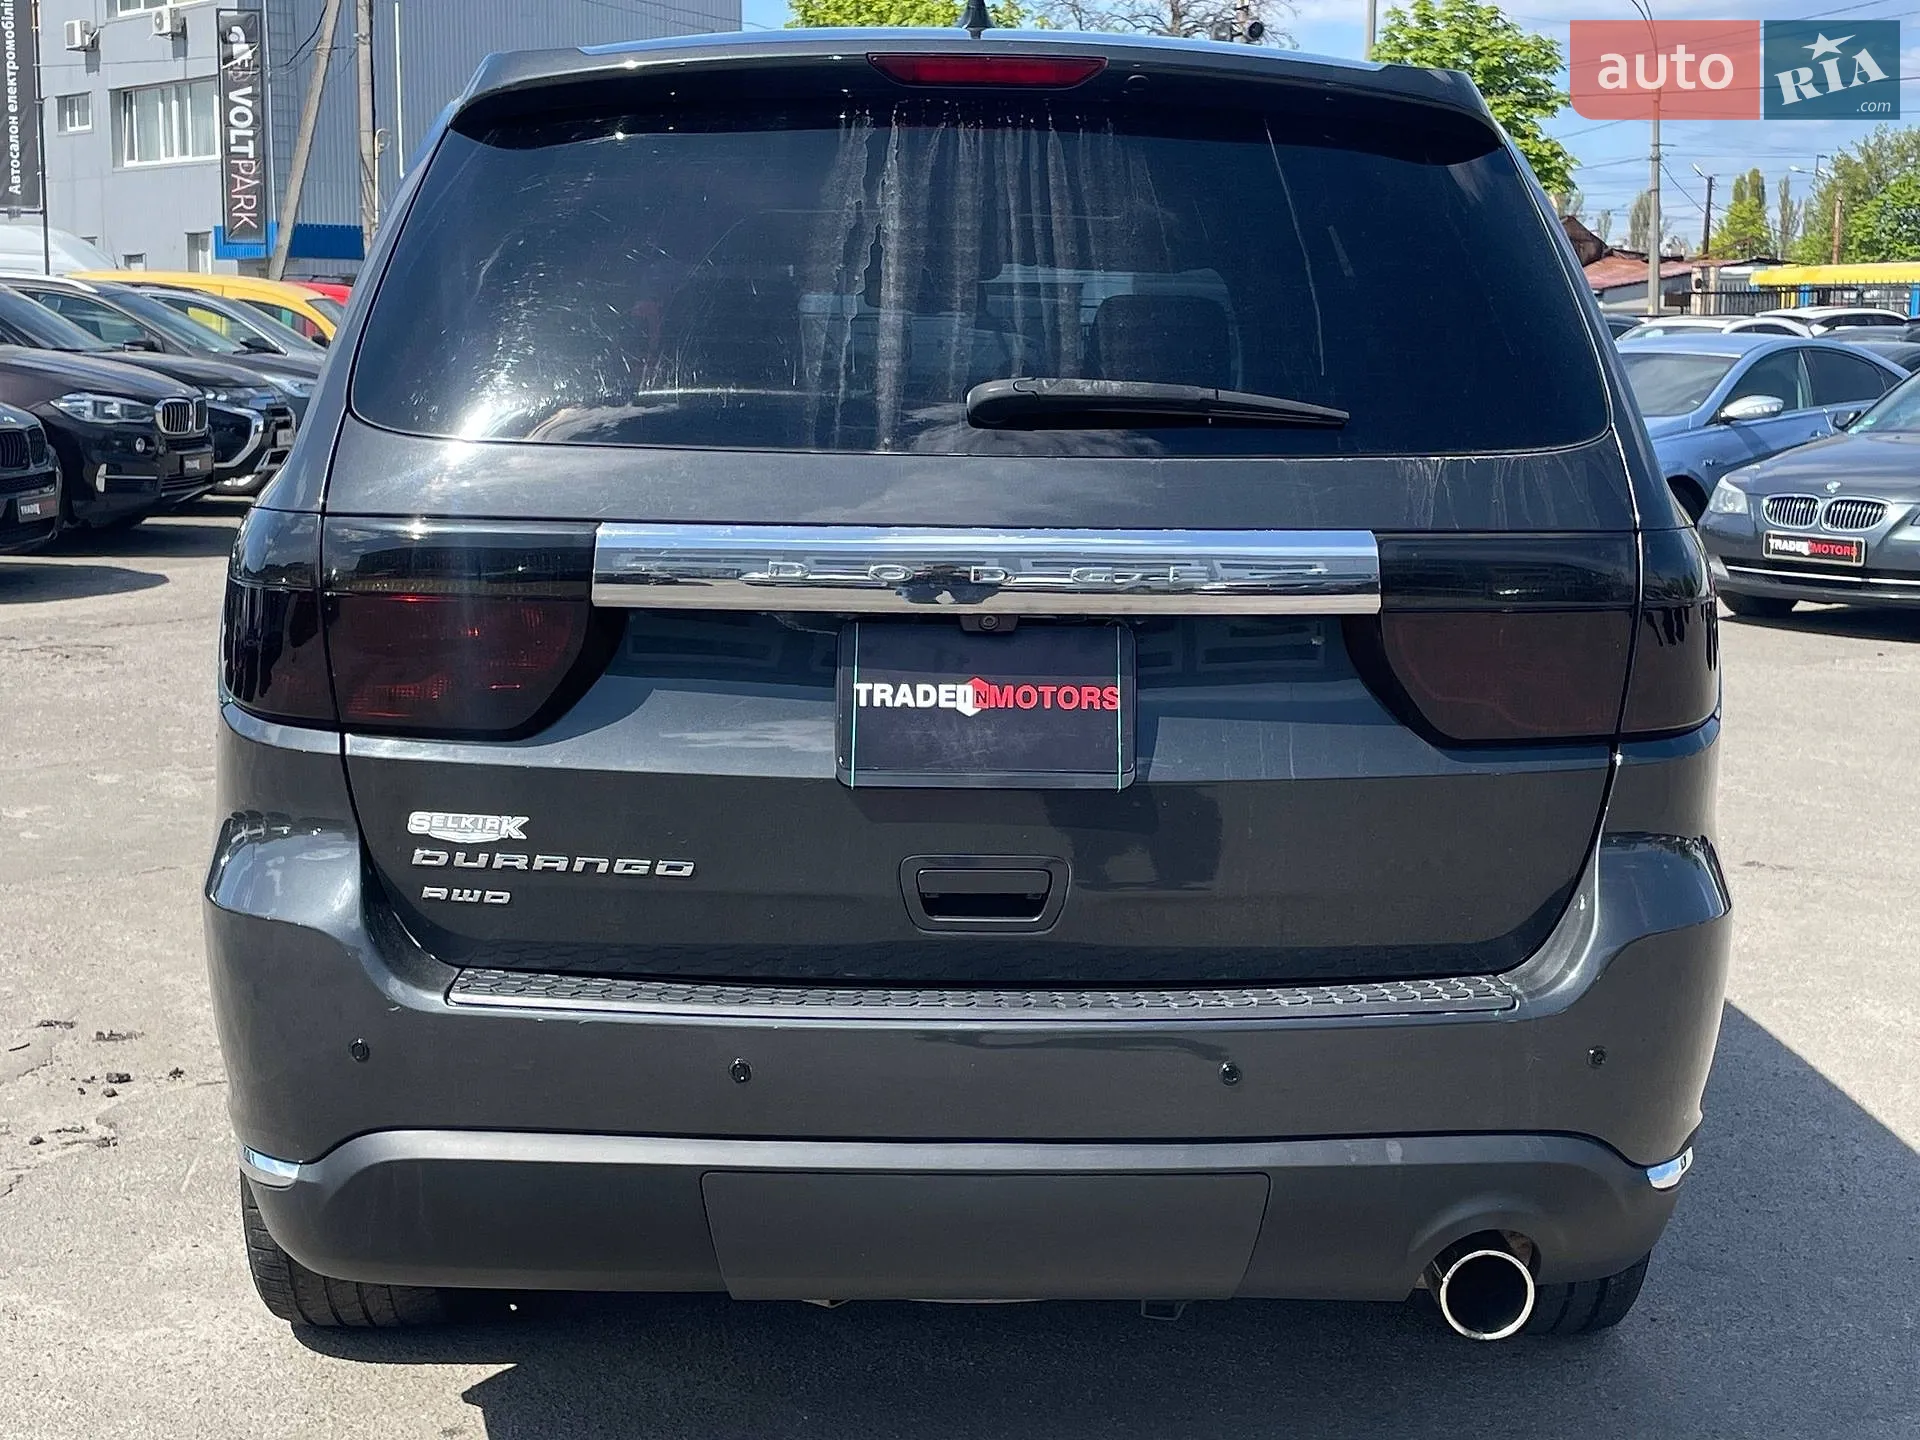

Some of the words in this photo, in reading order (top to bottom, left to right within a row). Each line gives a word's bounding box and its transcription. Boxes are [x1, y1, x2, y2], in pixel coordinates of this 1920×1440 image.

[0, 0, 19, 113] електромобілі
[8, 115, 22, 195] Автосалон
[407, 811, 530, 843] SELKIRK
[411, 848, 696, 878] DURANGO
[420, 886, 513, 904] AWD
